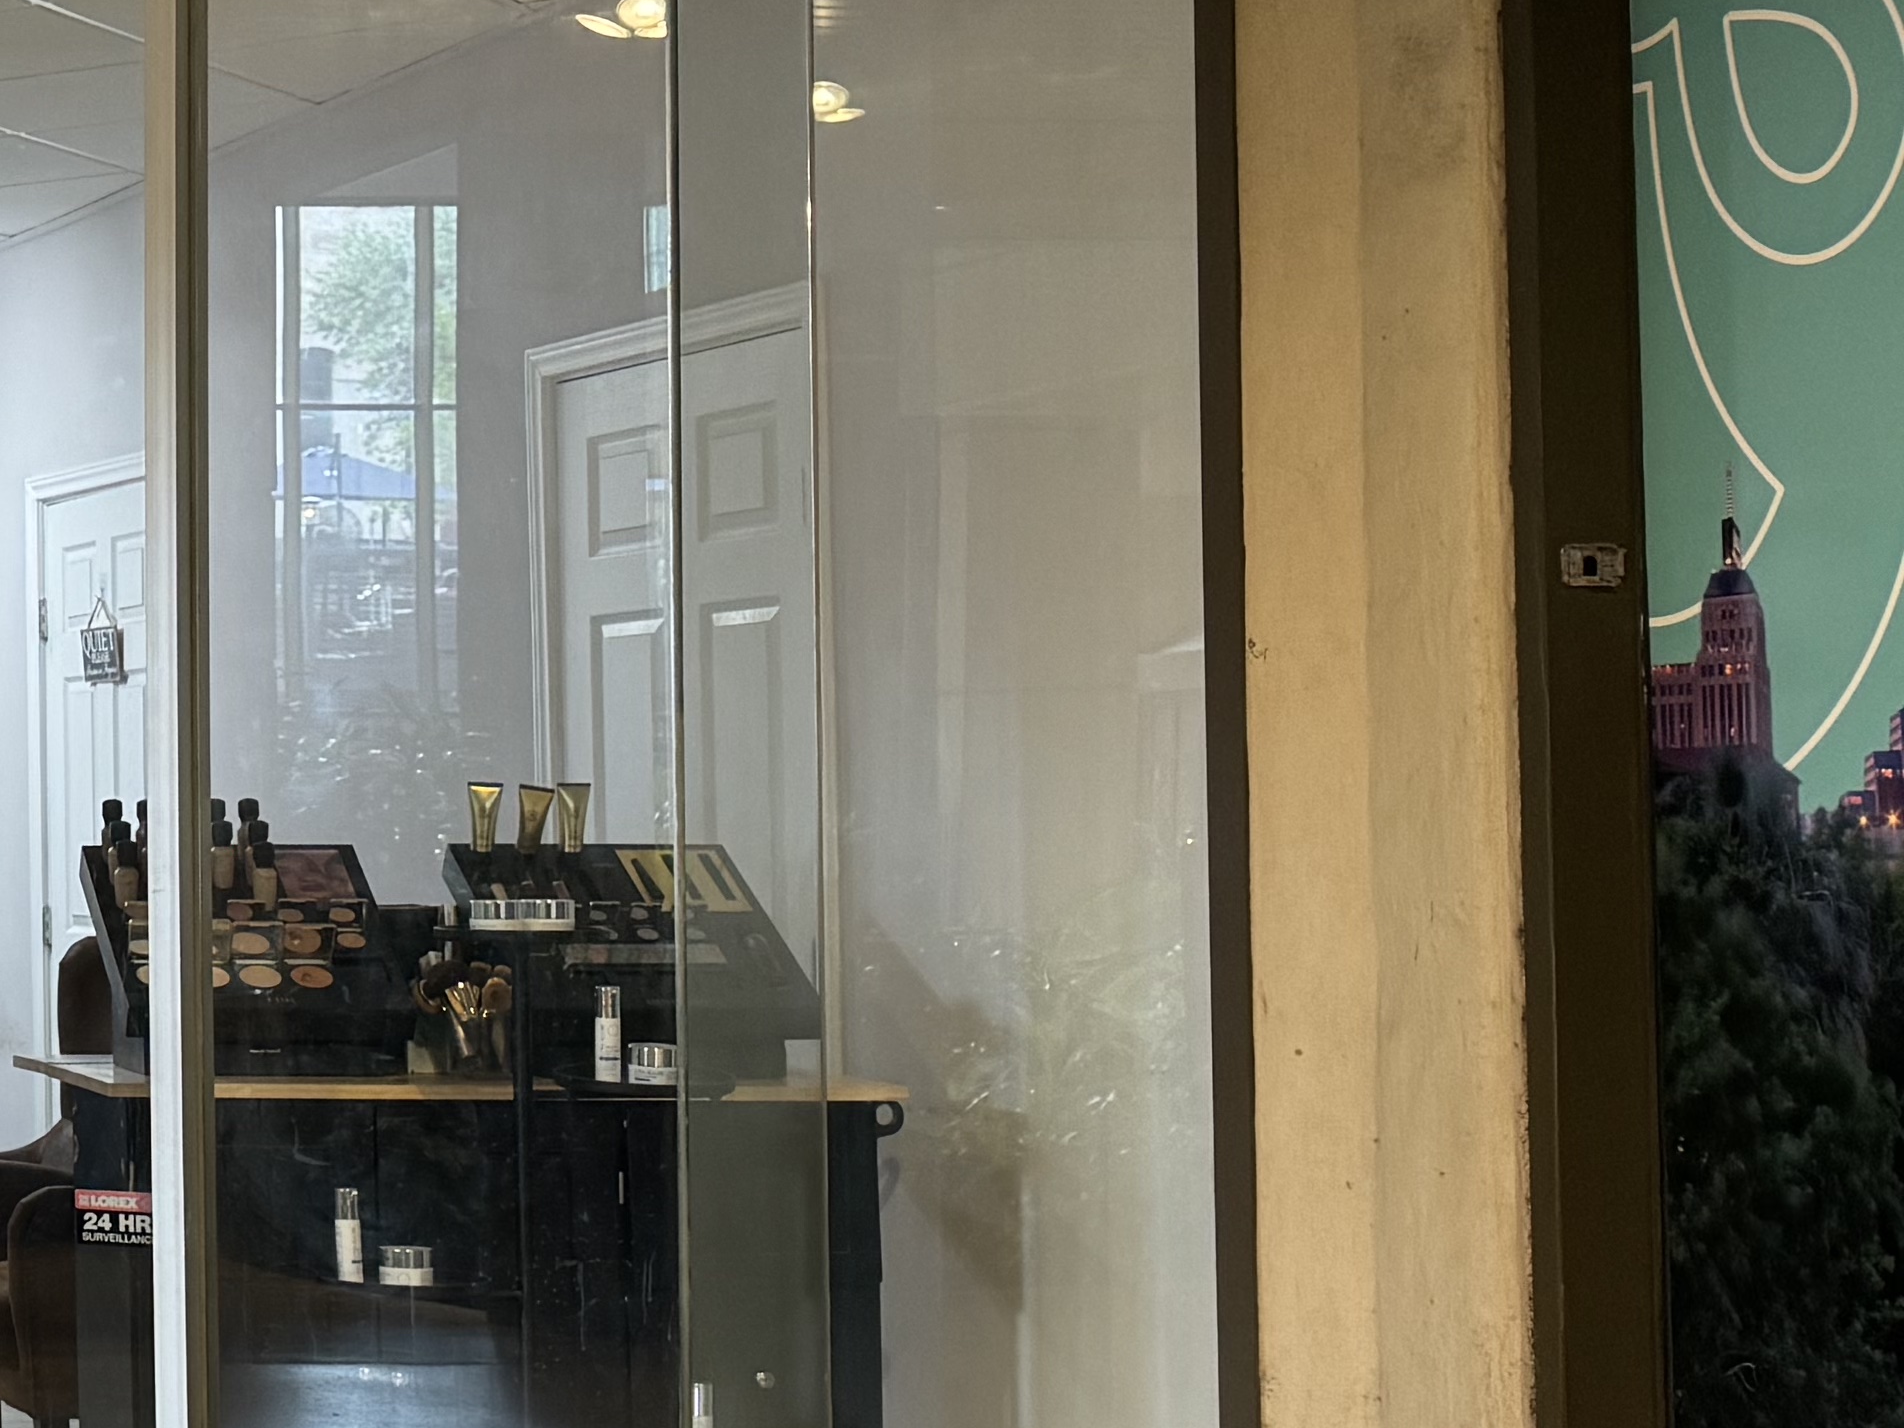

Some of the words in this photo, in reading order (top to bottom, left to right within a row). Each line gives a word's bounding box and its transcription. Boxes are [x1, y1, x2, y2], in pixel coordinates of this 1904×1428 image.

[82, 629, 114, 659] QUIET
[90, 1195, 139, 1209] LOREX
[82, 1211, 113, 1231] 24
[118, 1213, 152, 1234] HR
[81, 1231, 153, 1245] SURVEILLANC
